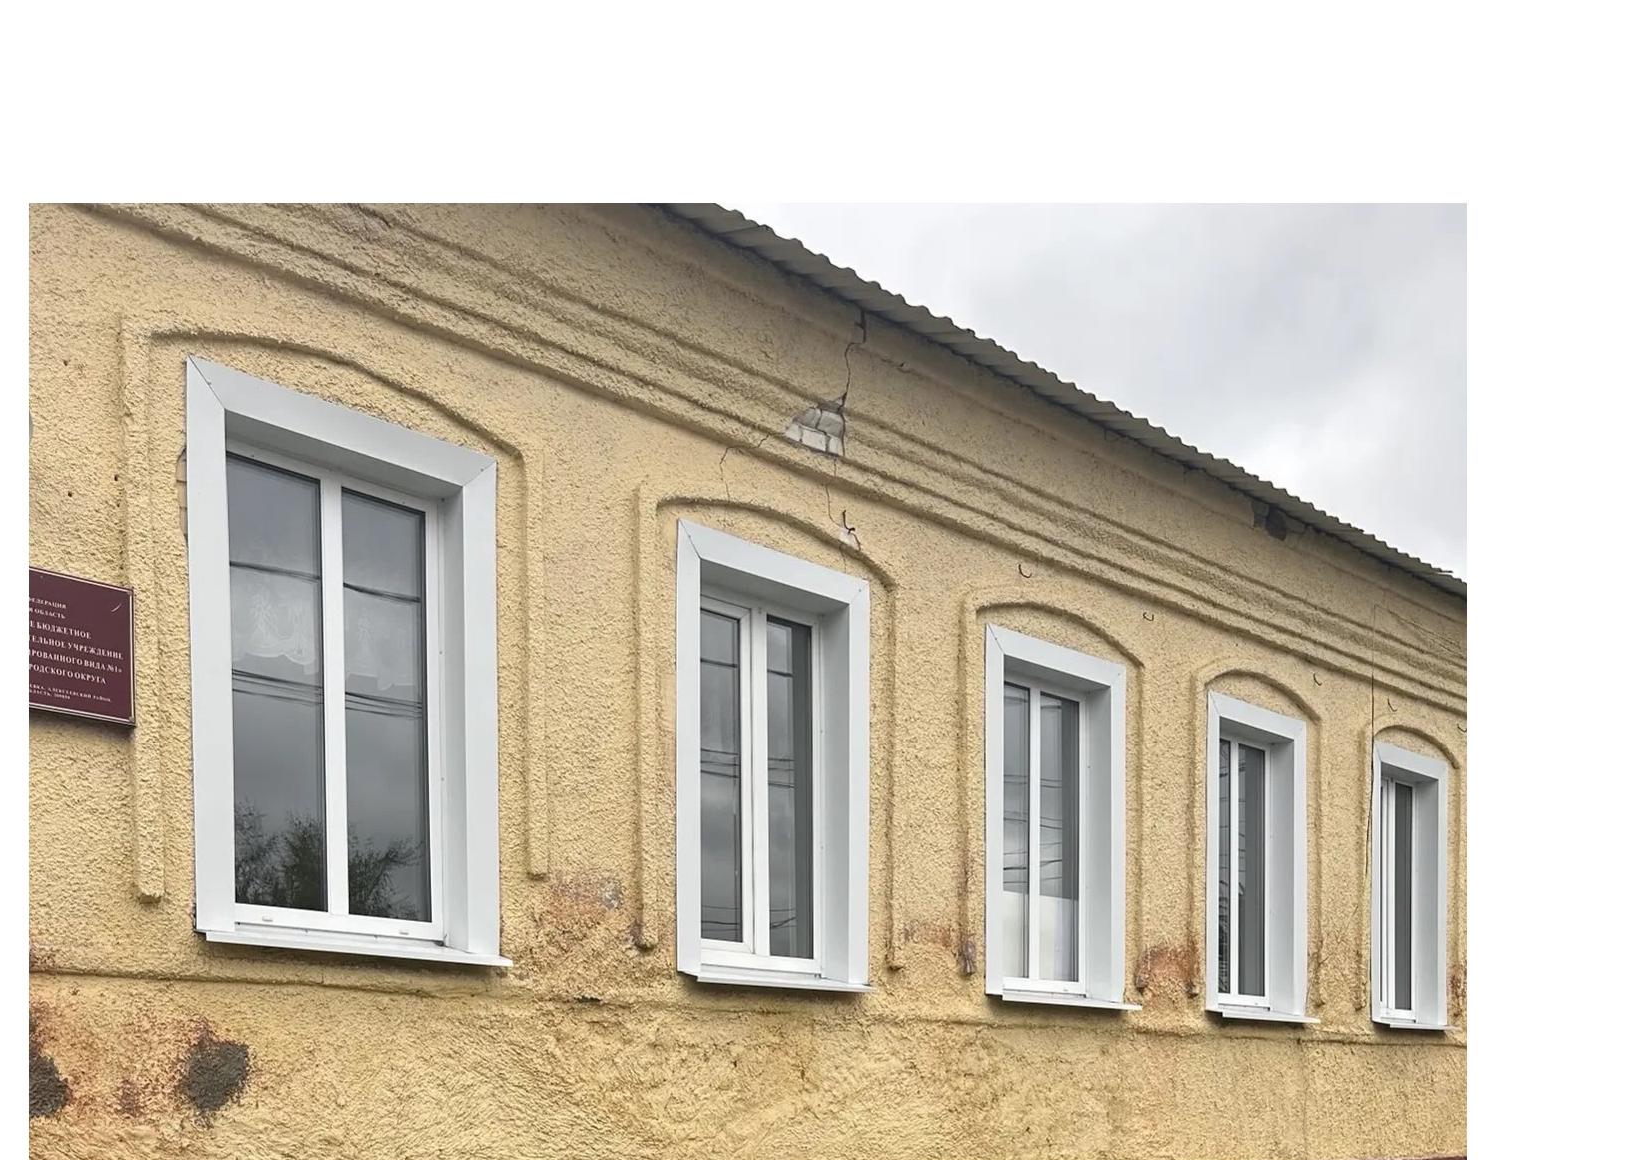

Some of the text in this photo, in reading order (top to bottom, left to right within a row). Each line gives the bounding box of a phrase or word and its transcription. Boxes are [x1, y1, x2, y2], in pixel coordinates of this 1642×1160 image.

[29, 597, 66, 609] ЕДЕРАЦИЯ
[37, 621, 91, 639] БЮДЖЕТНОЕ
[29, 635, 123, 660] ЕЛЬНОЕ УЧРЕЖДЕНИЕ
[29, 649, 83, 666] РОВАННОГО
[84, 659, 106, 670] ВИДА
[74, 671, 106, 684] ОКРУГА
